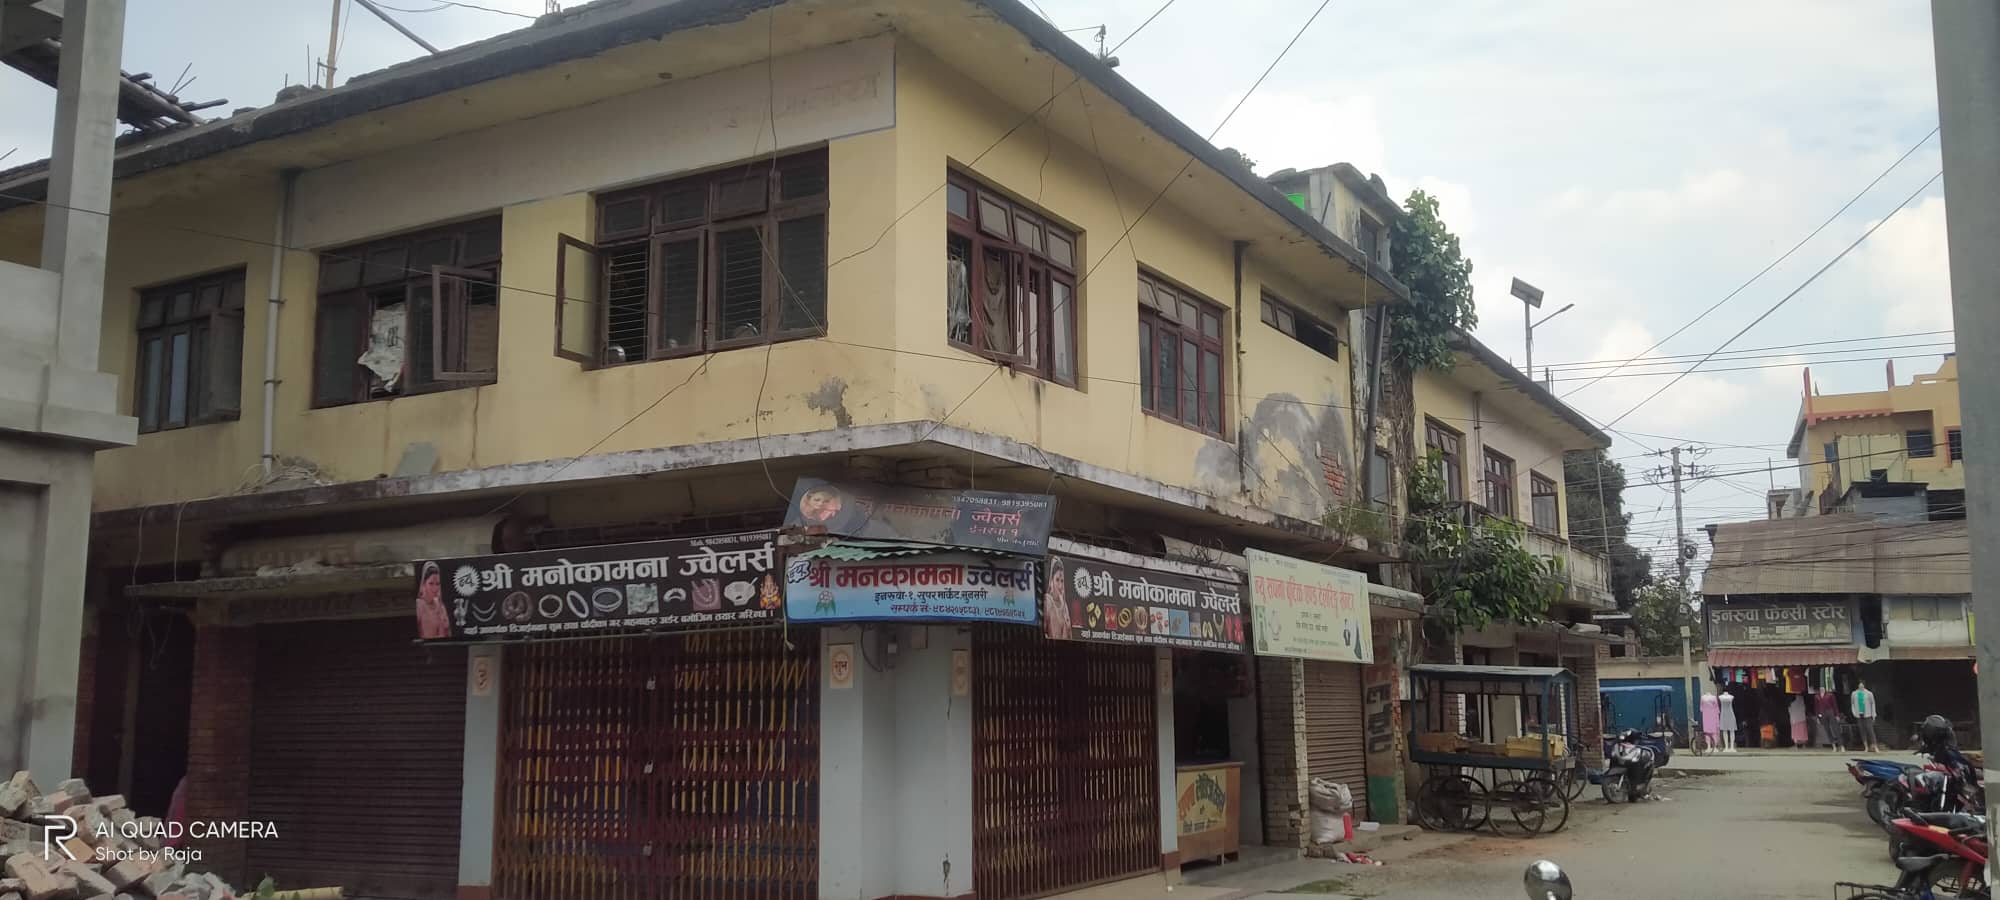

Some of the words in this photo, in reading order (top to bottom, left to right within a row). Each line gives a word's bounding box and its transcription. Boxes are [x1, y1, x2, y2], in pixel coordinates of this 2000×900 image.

[481, 562, 514, 592] श्री
[519, 556, 670, 588] मनोकामना
[676, 541, 775, 577] ज्वेलर्स
[809, 560, 832, 589] श्री
[835, 564, 965, 589] मनकामना
[966, 561, 1033, 592] ज्वेलर्स
[1093, 569, 1115, 598] श्री
[1118, 577, 1197, 608] मनोकामना
[1199, 587, 1241, 616] ज्वेलर्स
[1711, 607, 1760, 624] इनरुवा
[1811, 602, 1847, 621] स्टोर
